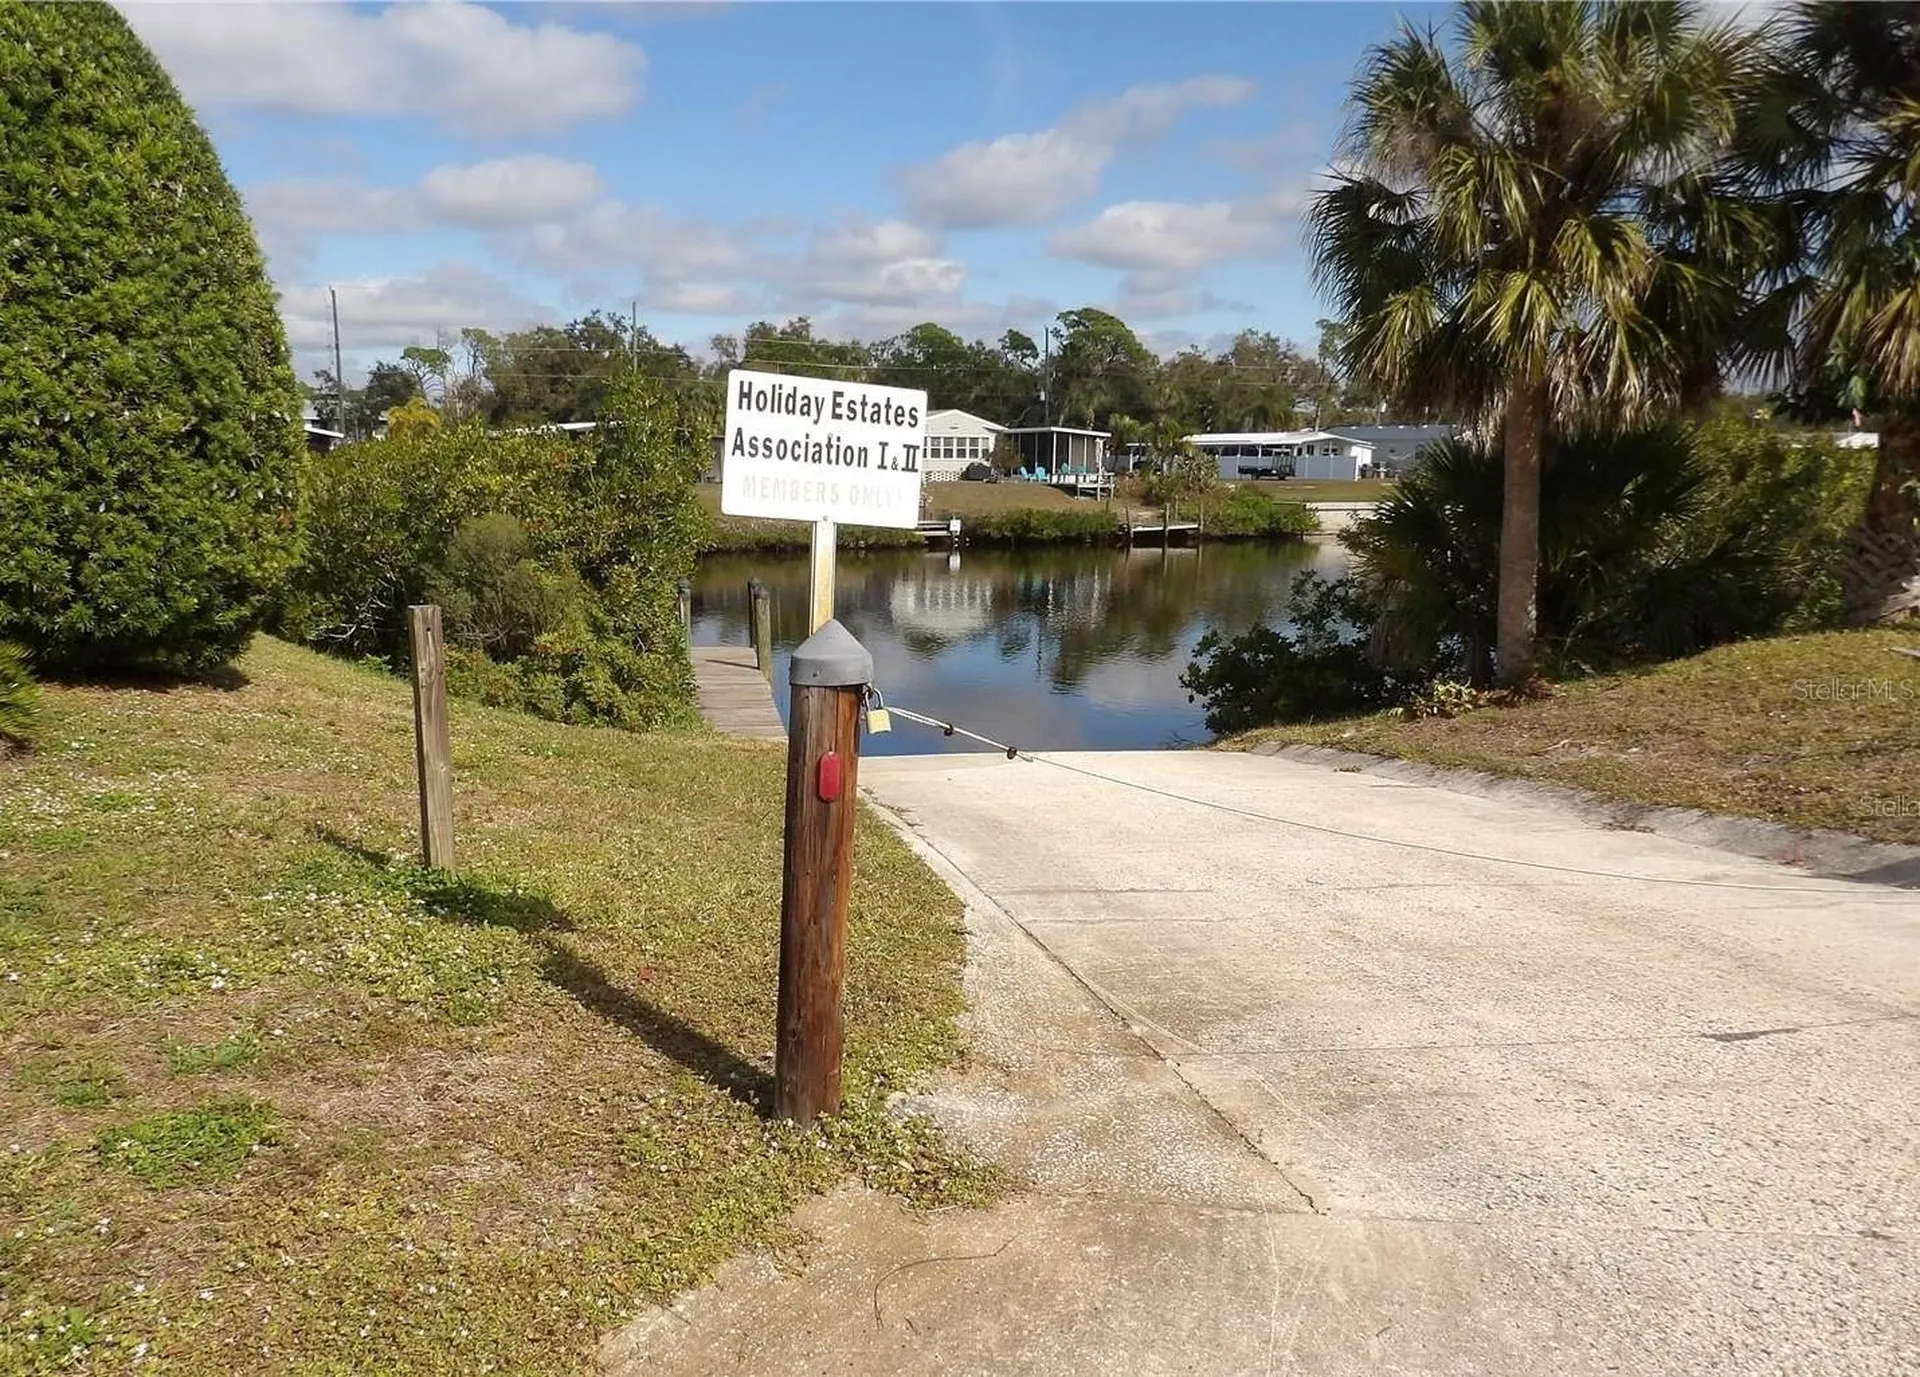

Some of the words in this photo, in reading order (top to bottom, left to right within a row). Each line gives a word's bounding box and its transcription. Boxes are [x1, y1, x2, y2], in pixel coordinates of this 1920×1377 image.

[738, 380, 825, 425] Holiday
[831, 390, 919, 428] Estates
[731, 427, 868, 468] Association
[742, 475, 839, 506] MEMBERS
